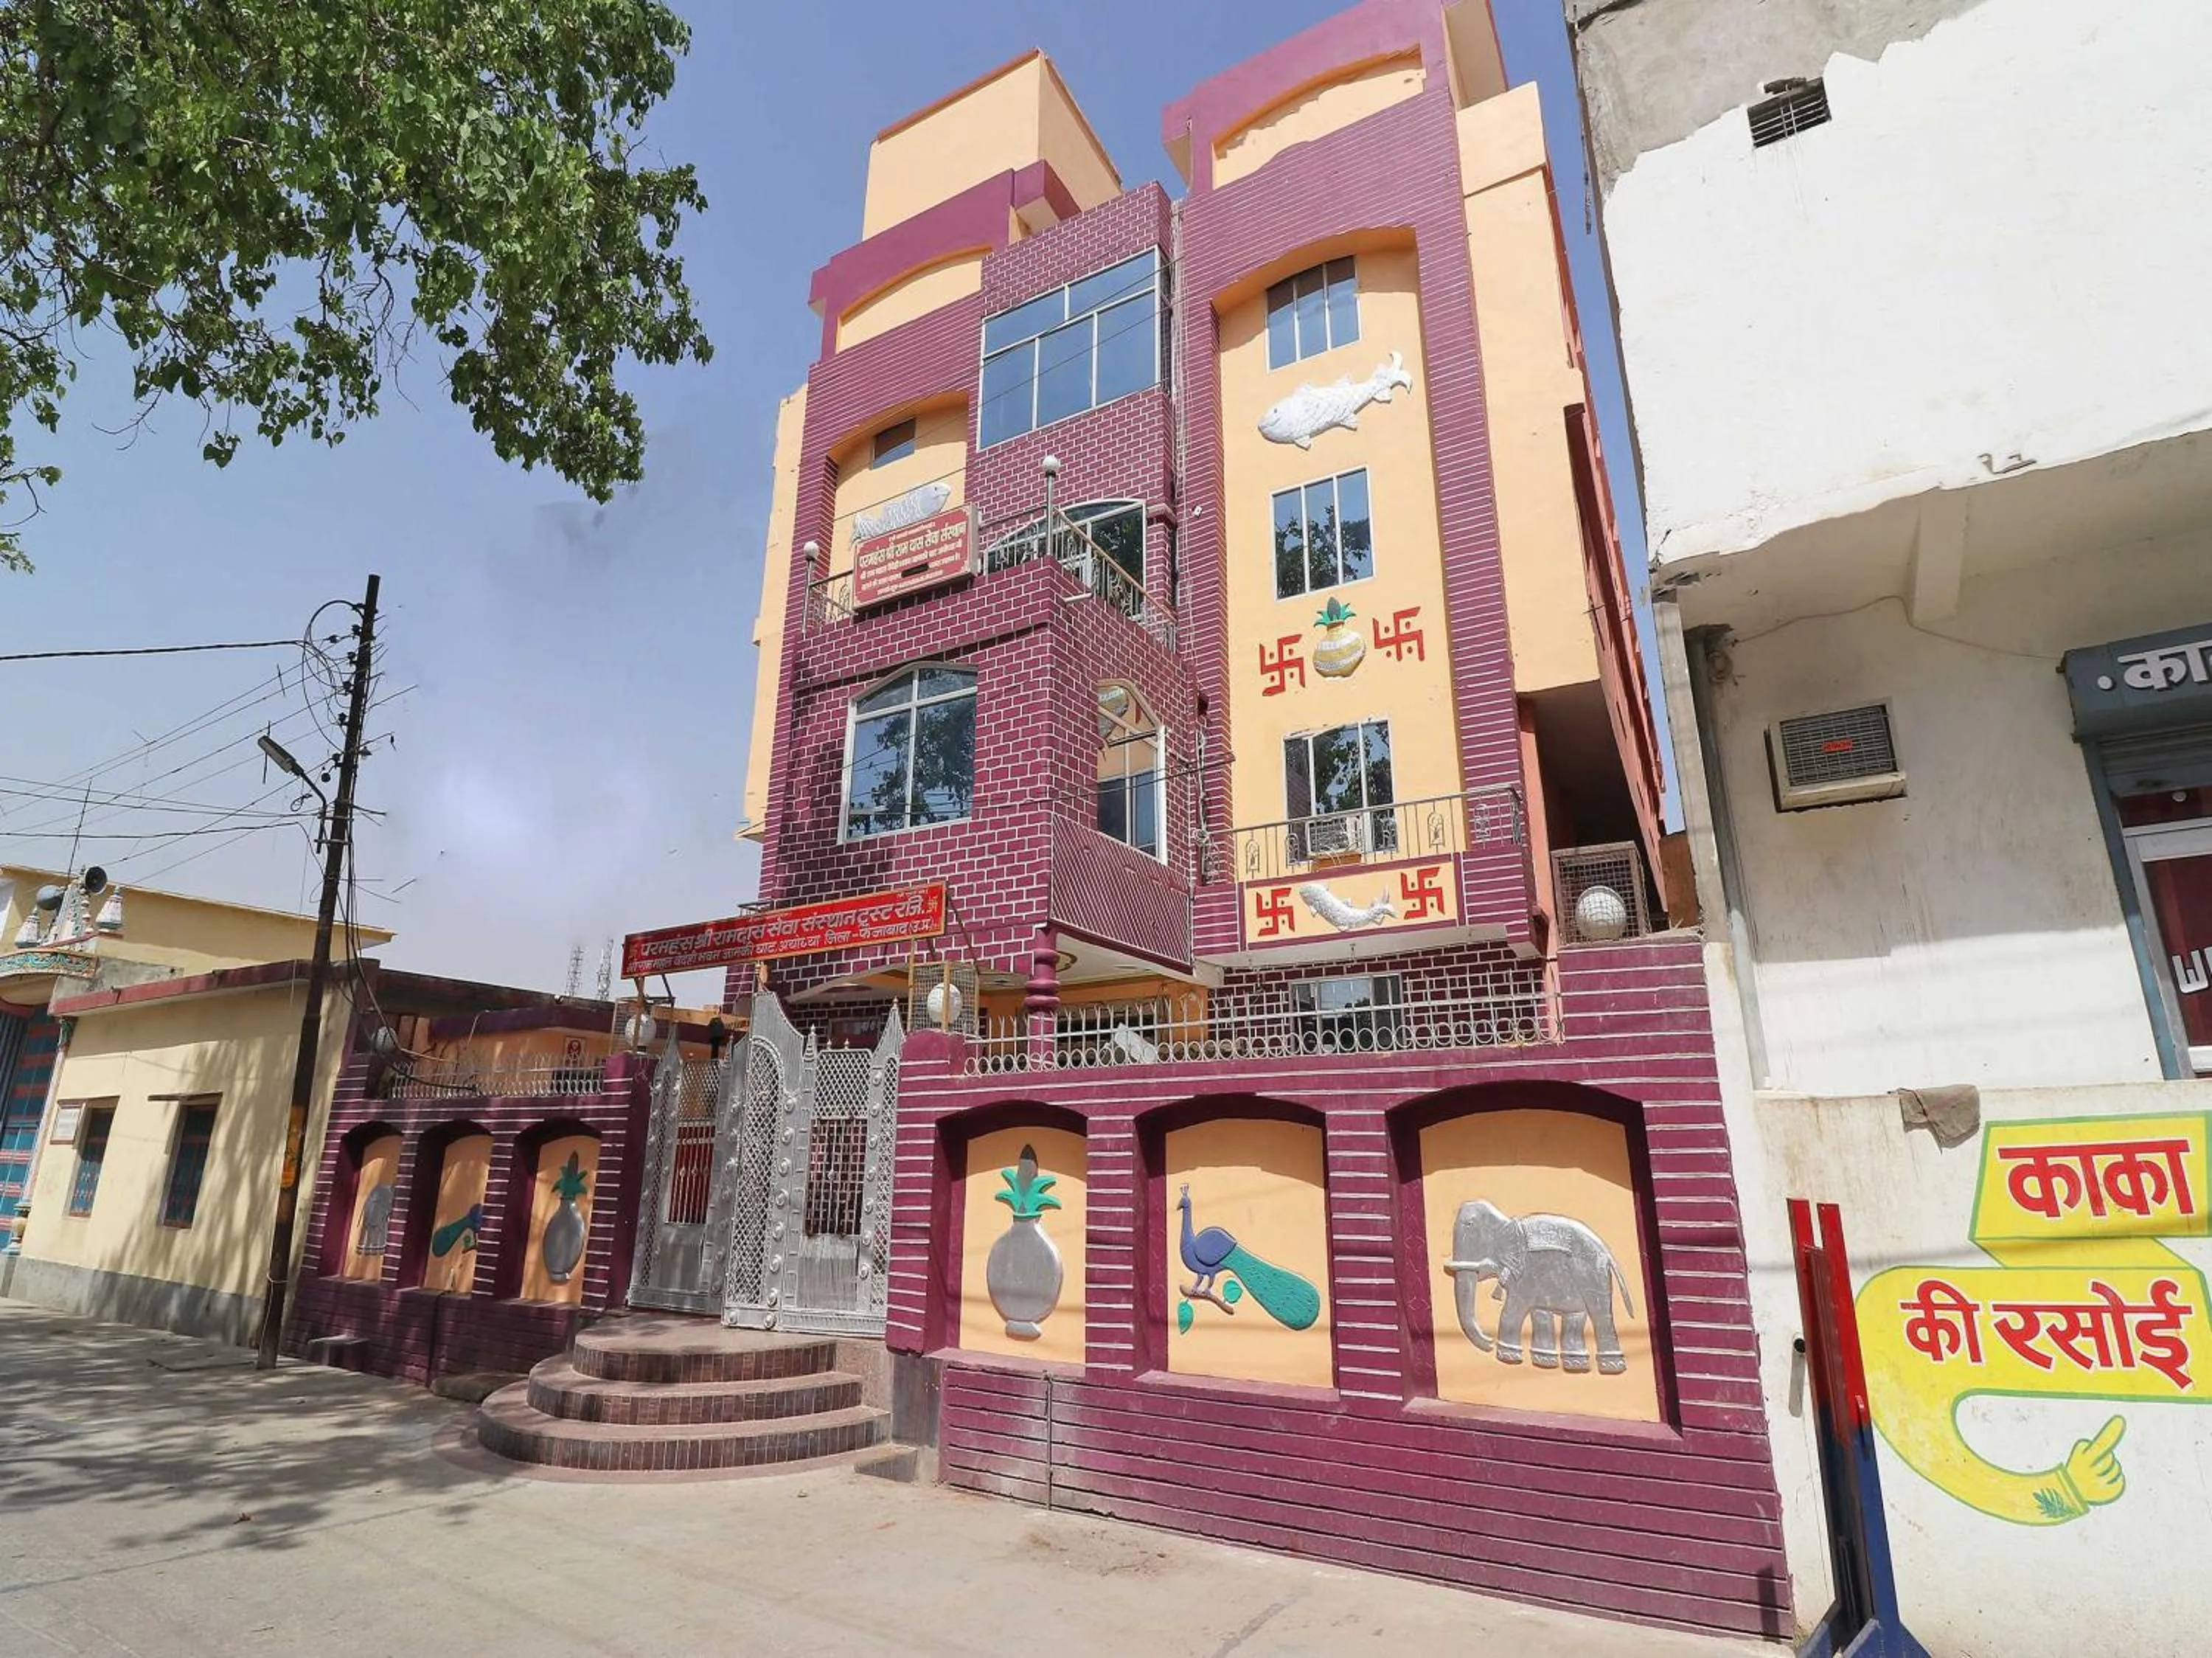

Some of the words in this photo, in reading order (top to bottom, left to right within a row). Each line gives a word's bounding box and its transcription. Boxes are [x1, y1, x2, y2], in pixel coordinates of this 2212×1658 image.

[1999, 1140, 2194, 1217] काका
[1901, 1280, 1982, 1363] की
[1993, 1280, 2192, 1389] रसोई
